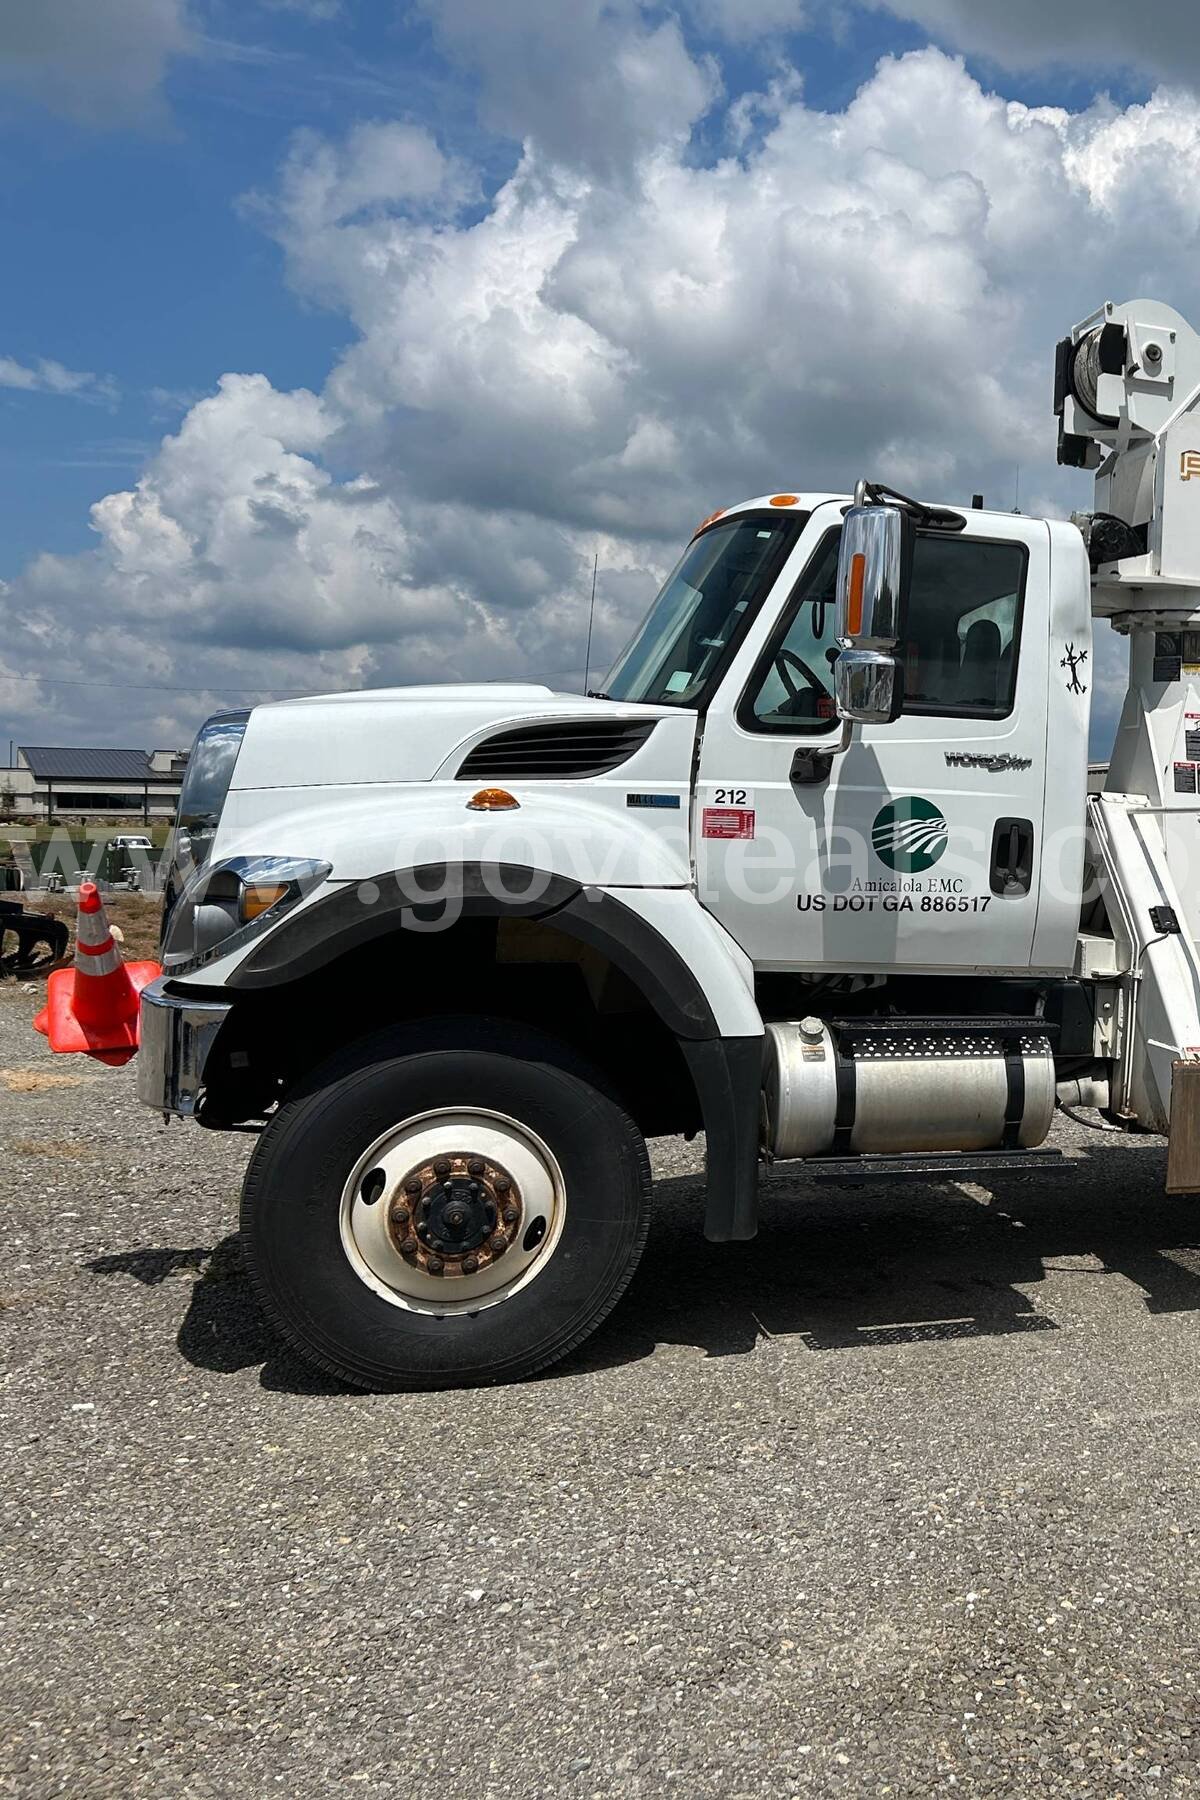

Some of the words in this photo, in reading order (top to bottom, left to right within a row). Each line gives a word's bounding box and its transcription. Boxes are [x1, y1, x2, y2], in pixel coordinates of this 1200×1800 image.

[714, 789, 747, 805] 212
[852, 877, 922, 893] Amicalola
[928, 878, 963, 893] EMC
[796, 894, 826, 912] US
[833, 894, 879, 912] DOT
[882, 895, 914, 912] GA
[920, 896, 992, 913] 886517
